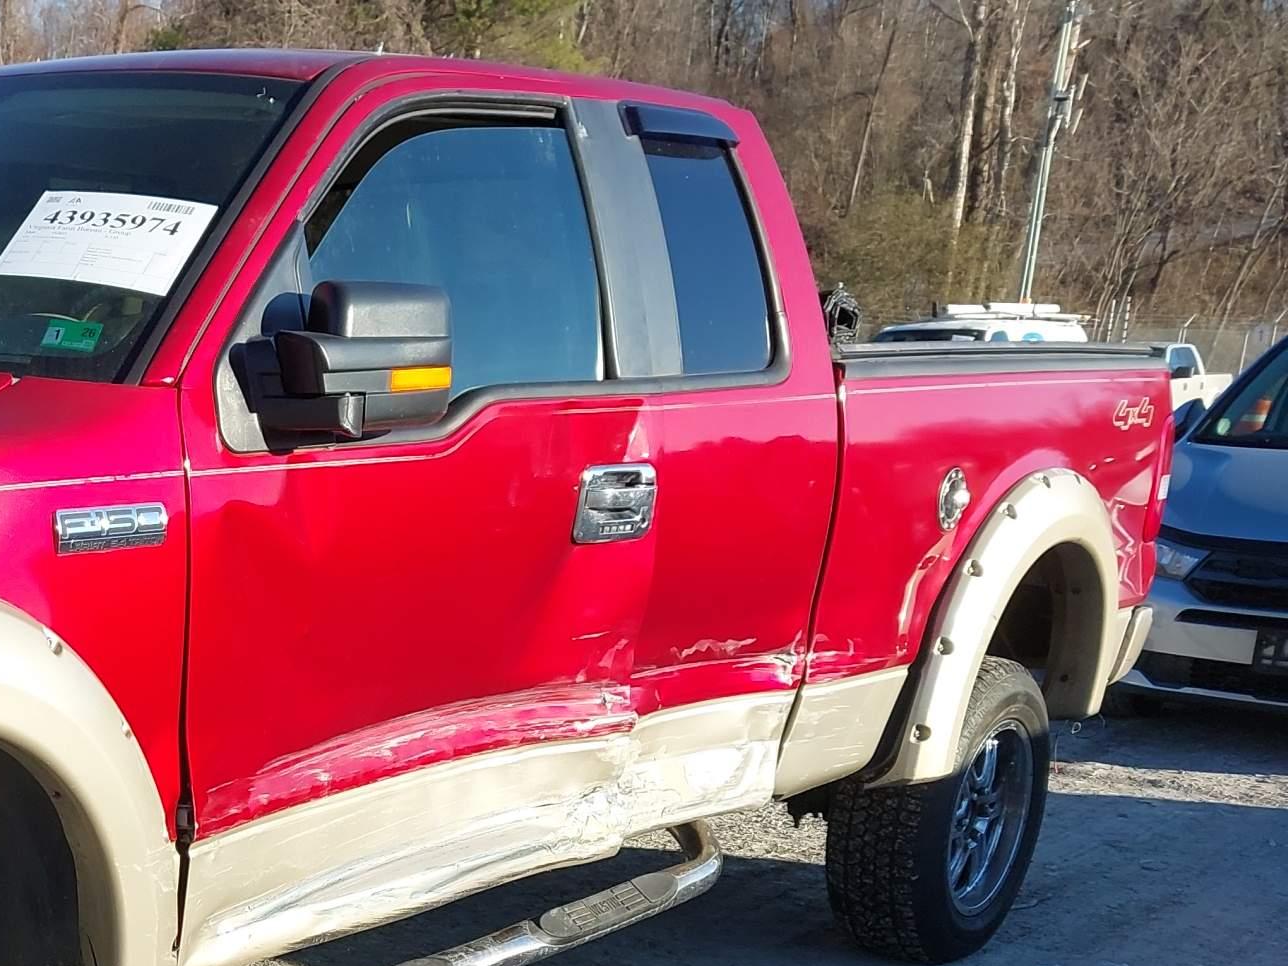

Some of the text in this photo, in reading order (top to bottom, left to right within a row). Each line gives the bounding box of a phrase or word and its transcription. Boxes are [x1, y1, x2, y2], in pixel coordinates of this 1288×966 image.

[43, 209, 183, 236] 43935974
[55, 328, 61, 340] 1
[82, 327, 97, 338] 26
